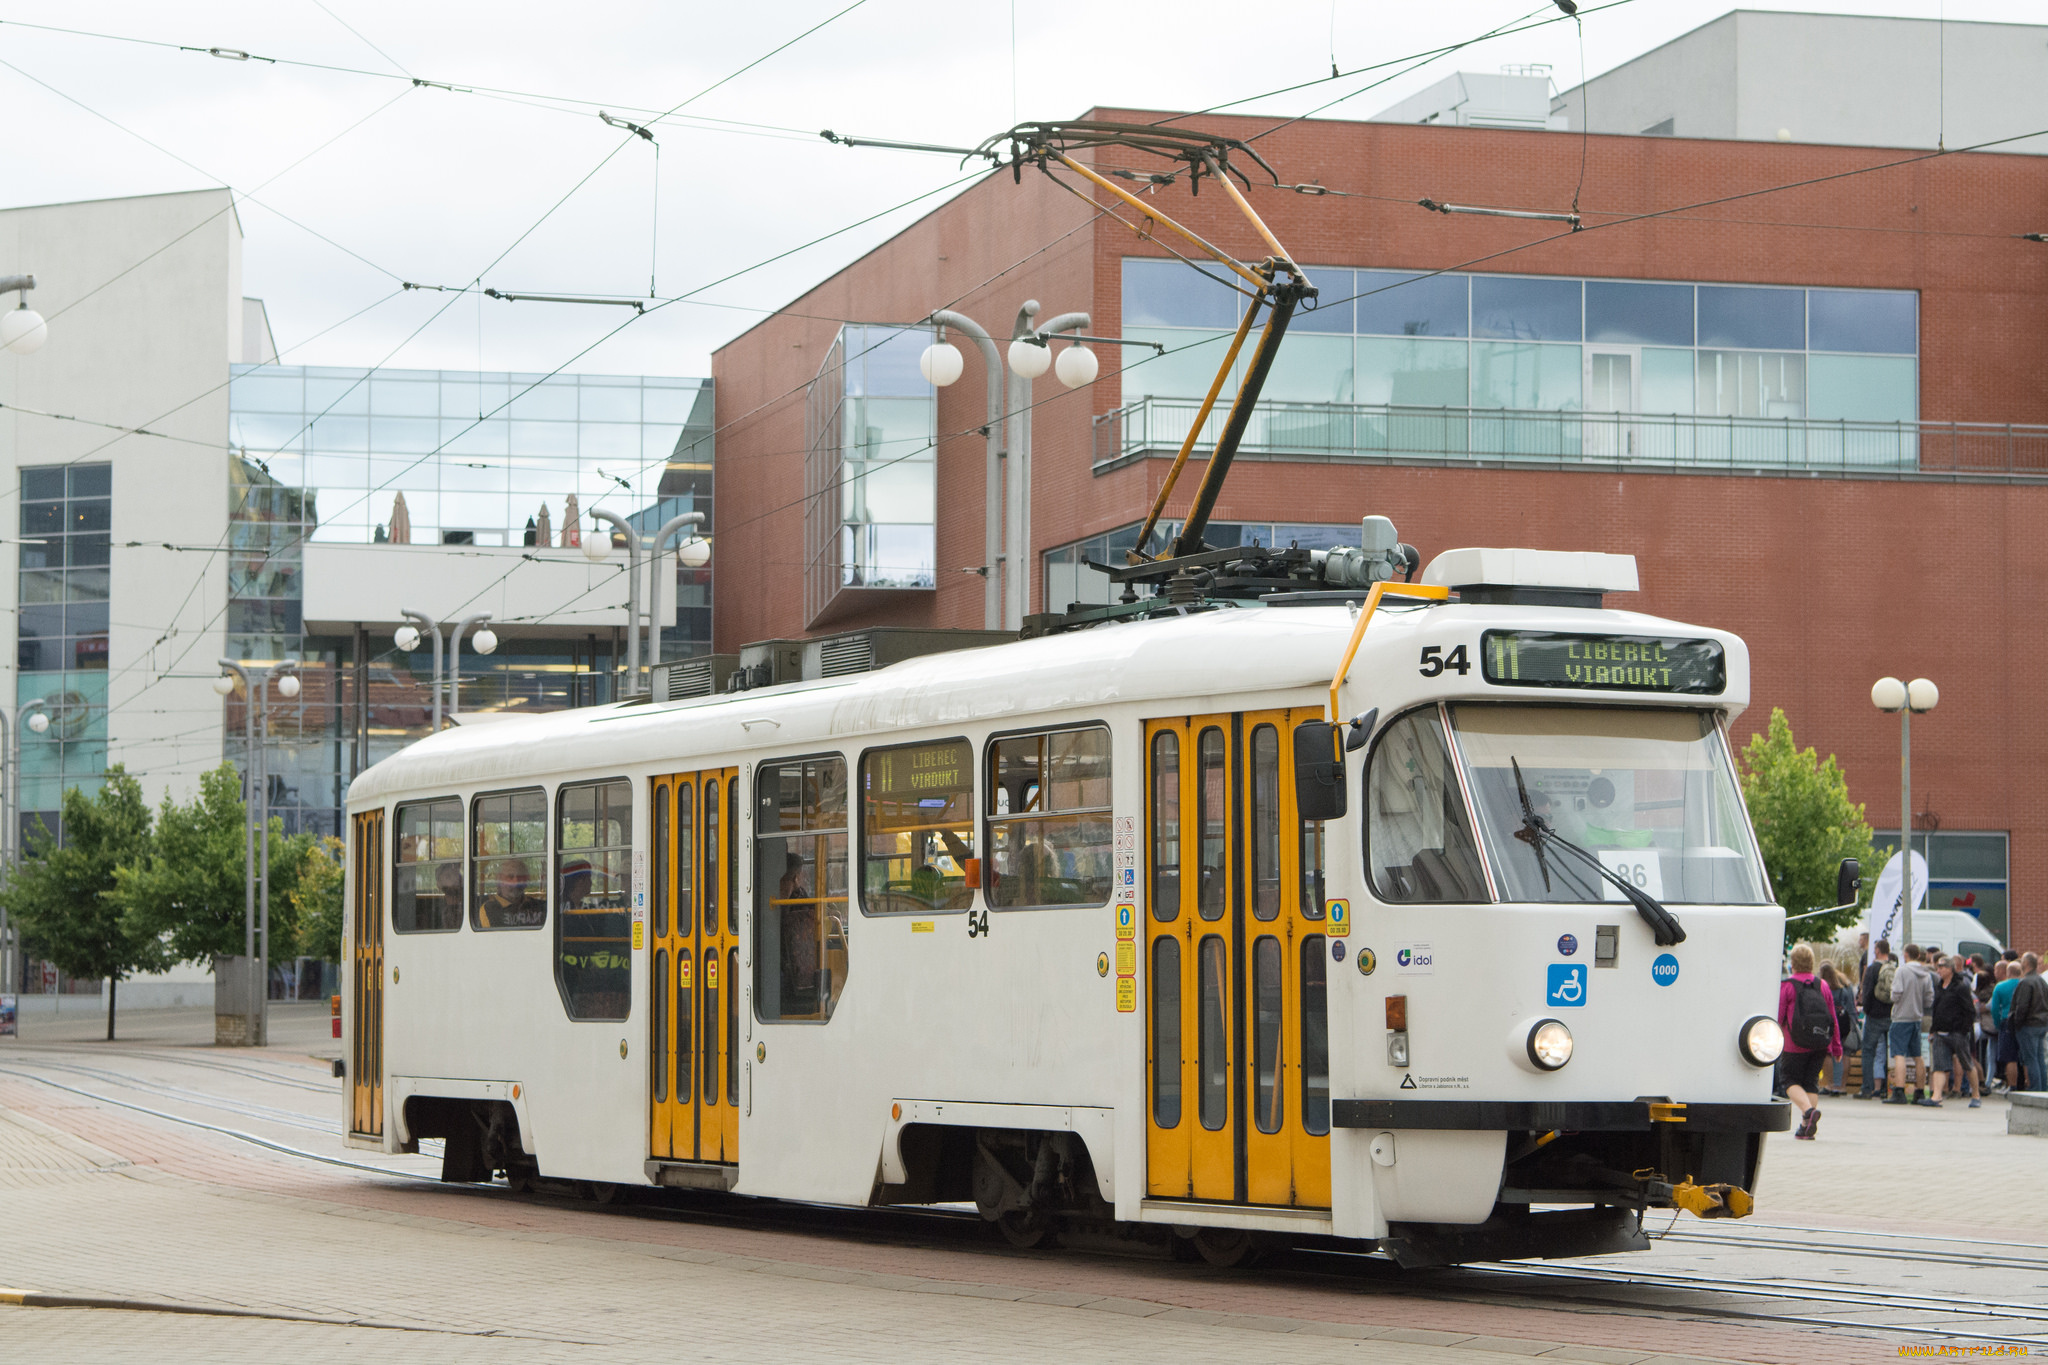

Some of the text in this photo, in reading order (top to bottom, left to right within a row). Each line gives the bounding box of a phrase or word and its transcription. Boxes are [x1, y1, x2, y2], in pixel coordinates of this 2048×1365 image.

[1418, 644, 1471, 677] 54
[1490, 636, 1519, 679] 11
[1568, 641, 1668, 662] LIBEREC
[1564, 664, 1673, 686] VIADUKT
[912, 748, 958, 769] LIBEREC
[881, 752, 893, 792] 11
[911, 769, 959, 789] VIADUKT
[1616, 863, 1648, 889] 86
[967, 910, 989, 939] 54
[1413, 954, 1432, 966] idol
[1653, 965, 1677, 976] 1000
